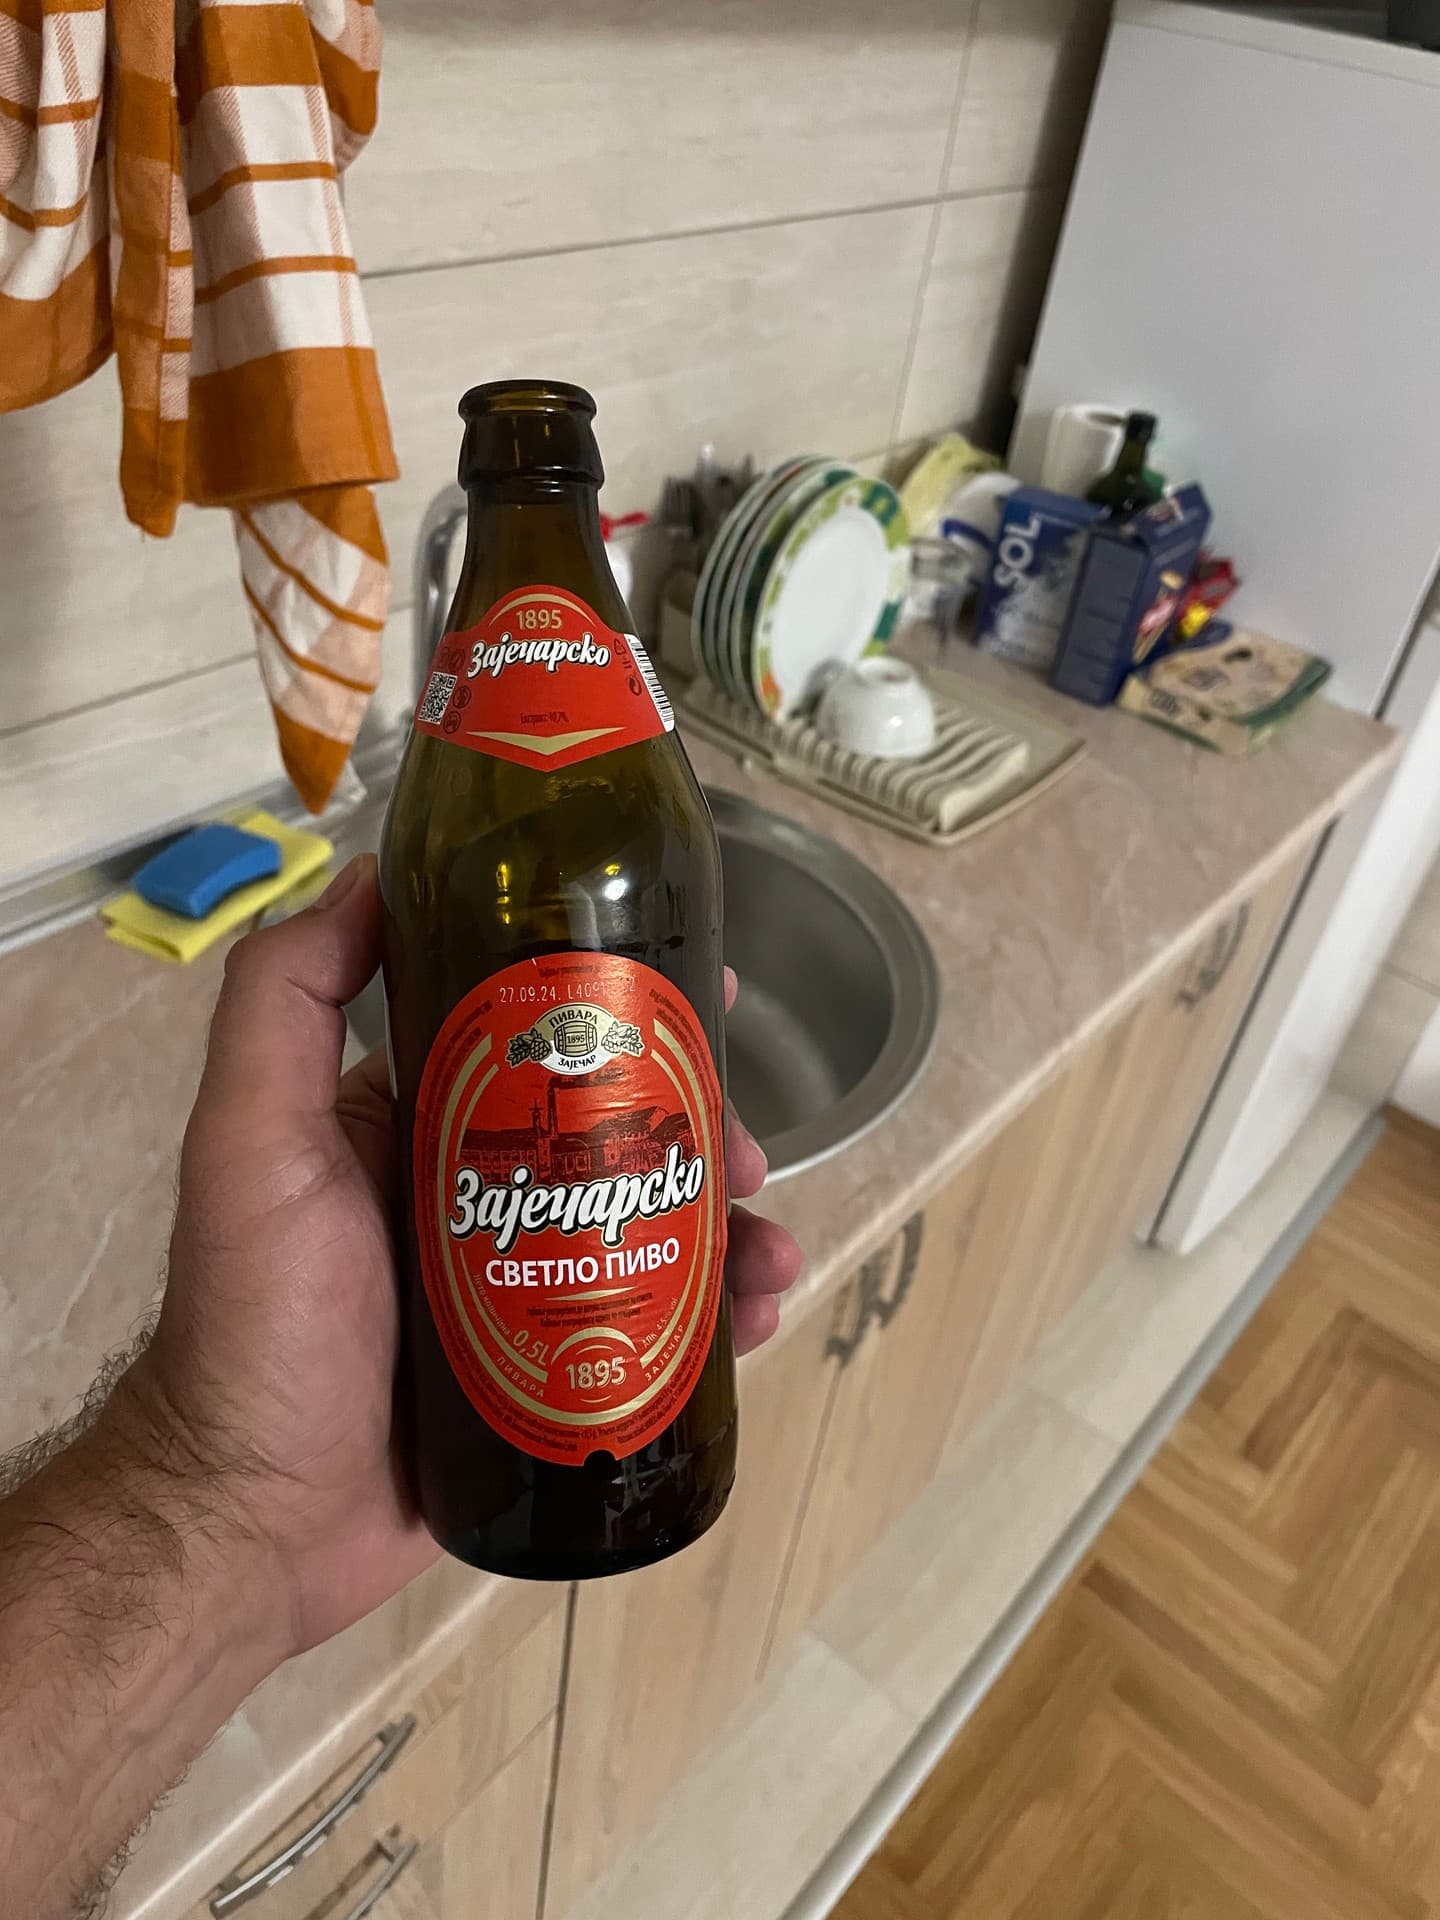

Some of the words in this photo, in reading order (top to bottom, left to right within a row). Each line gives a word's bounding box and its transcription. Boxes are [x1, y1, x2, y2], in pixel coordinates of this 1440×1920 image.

[993, 515, 1042, 587] SOL
[516, 609, 563, 630] 1895
[467, 632, 612, 678] Зајечарско
[548, 1009, 598, 1029] ПИВАРА
[567, 1034, 585, 1044] 1895
[558, 1054, 597, 1070] ЗАЈЕЧАР
[450, 1142, 705, 1256] Зајечарско
[485, 1256, 599, 1287] СВЕТЛО
[605, 1237, 680, 1280] ПИВО
[512, 1329, 549, 1367] 0,5L
[644, 1324, 684, 1381] ЗАЈЕЧАР
[497, 1357, 544, 1398] ПИВАРА
[565, 1356, 627, 1390] 1895
